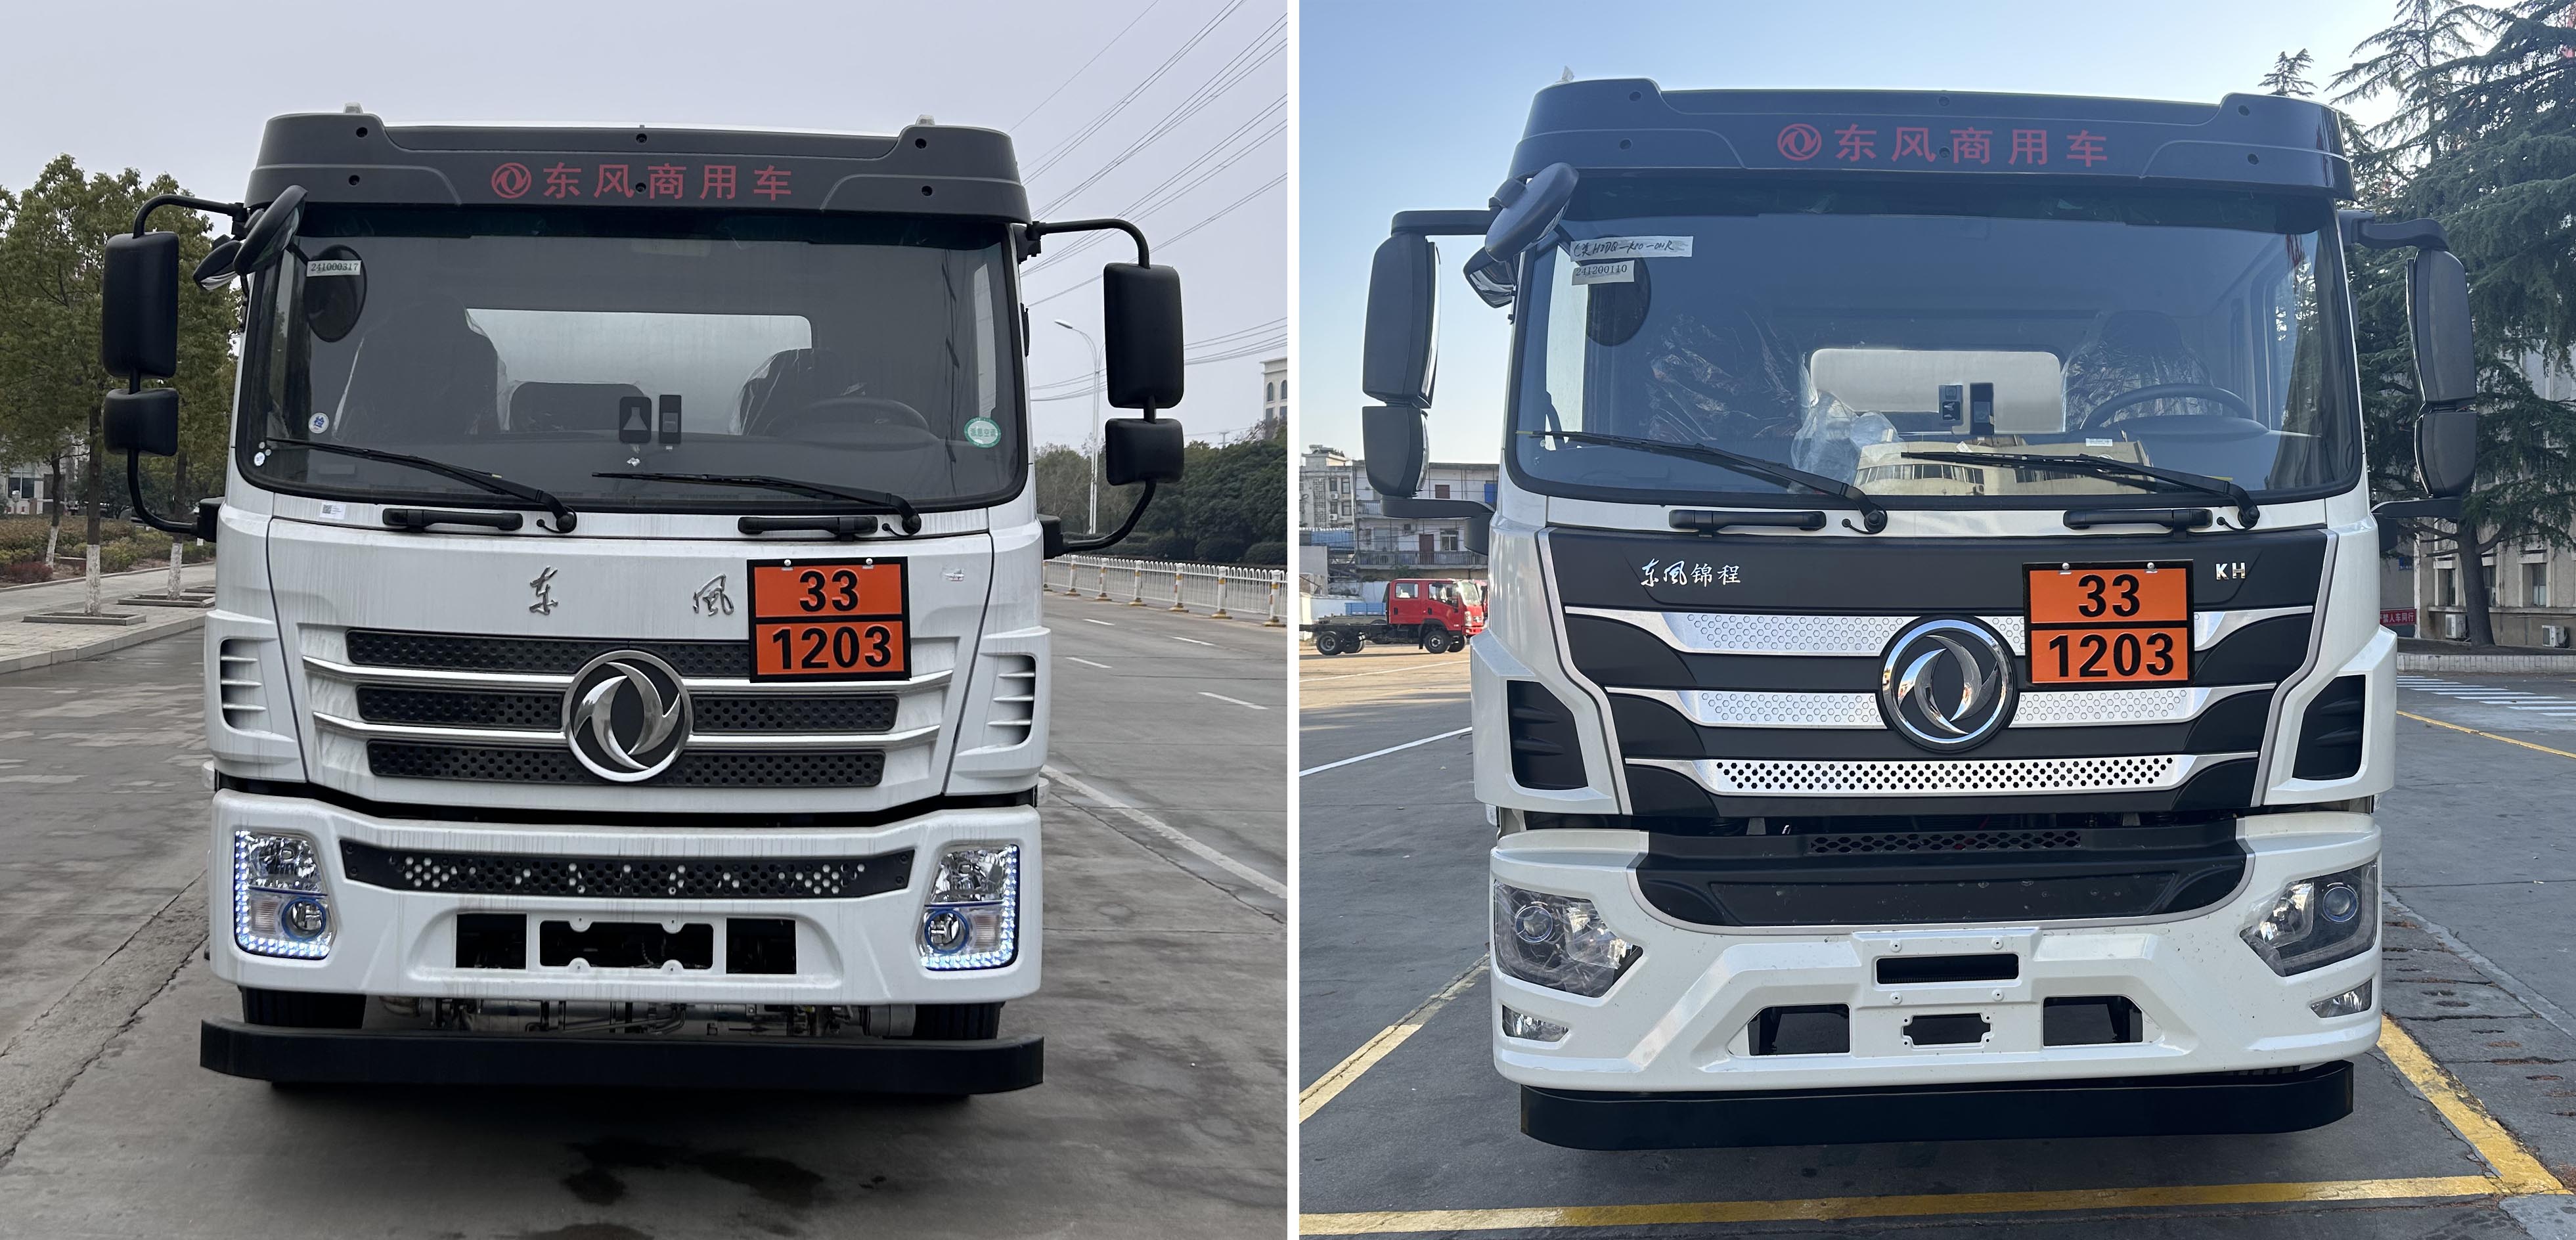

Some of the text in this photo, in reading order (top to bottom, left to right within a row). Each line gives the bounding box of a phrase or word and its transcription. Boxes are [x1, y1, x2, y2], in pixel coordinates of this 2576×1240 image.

[1835, 123, 2108, 167] 东风商用车
[543, 162, 791, 200] 东风商用车
[311, 263, 359, 271] 241000317
[1576, 265, 1627, 276] 241200110
[799, 569, 858, 612] 33
[1641, 558, 1741, 588] 东风锦程
[2215, 564, 2246, 580] KH
[2078, 574, 2141, 617] 33
[772, 626, 891, 670] 1203
[2049, 632, 2173, 678] 1203
